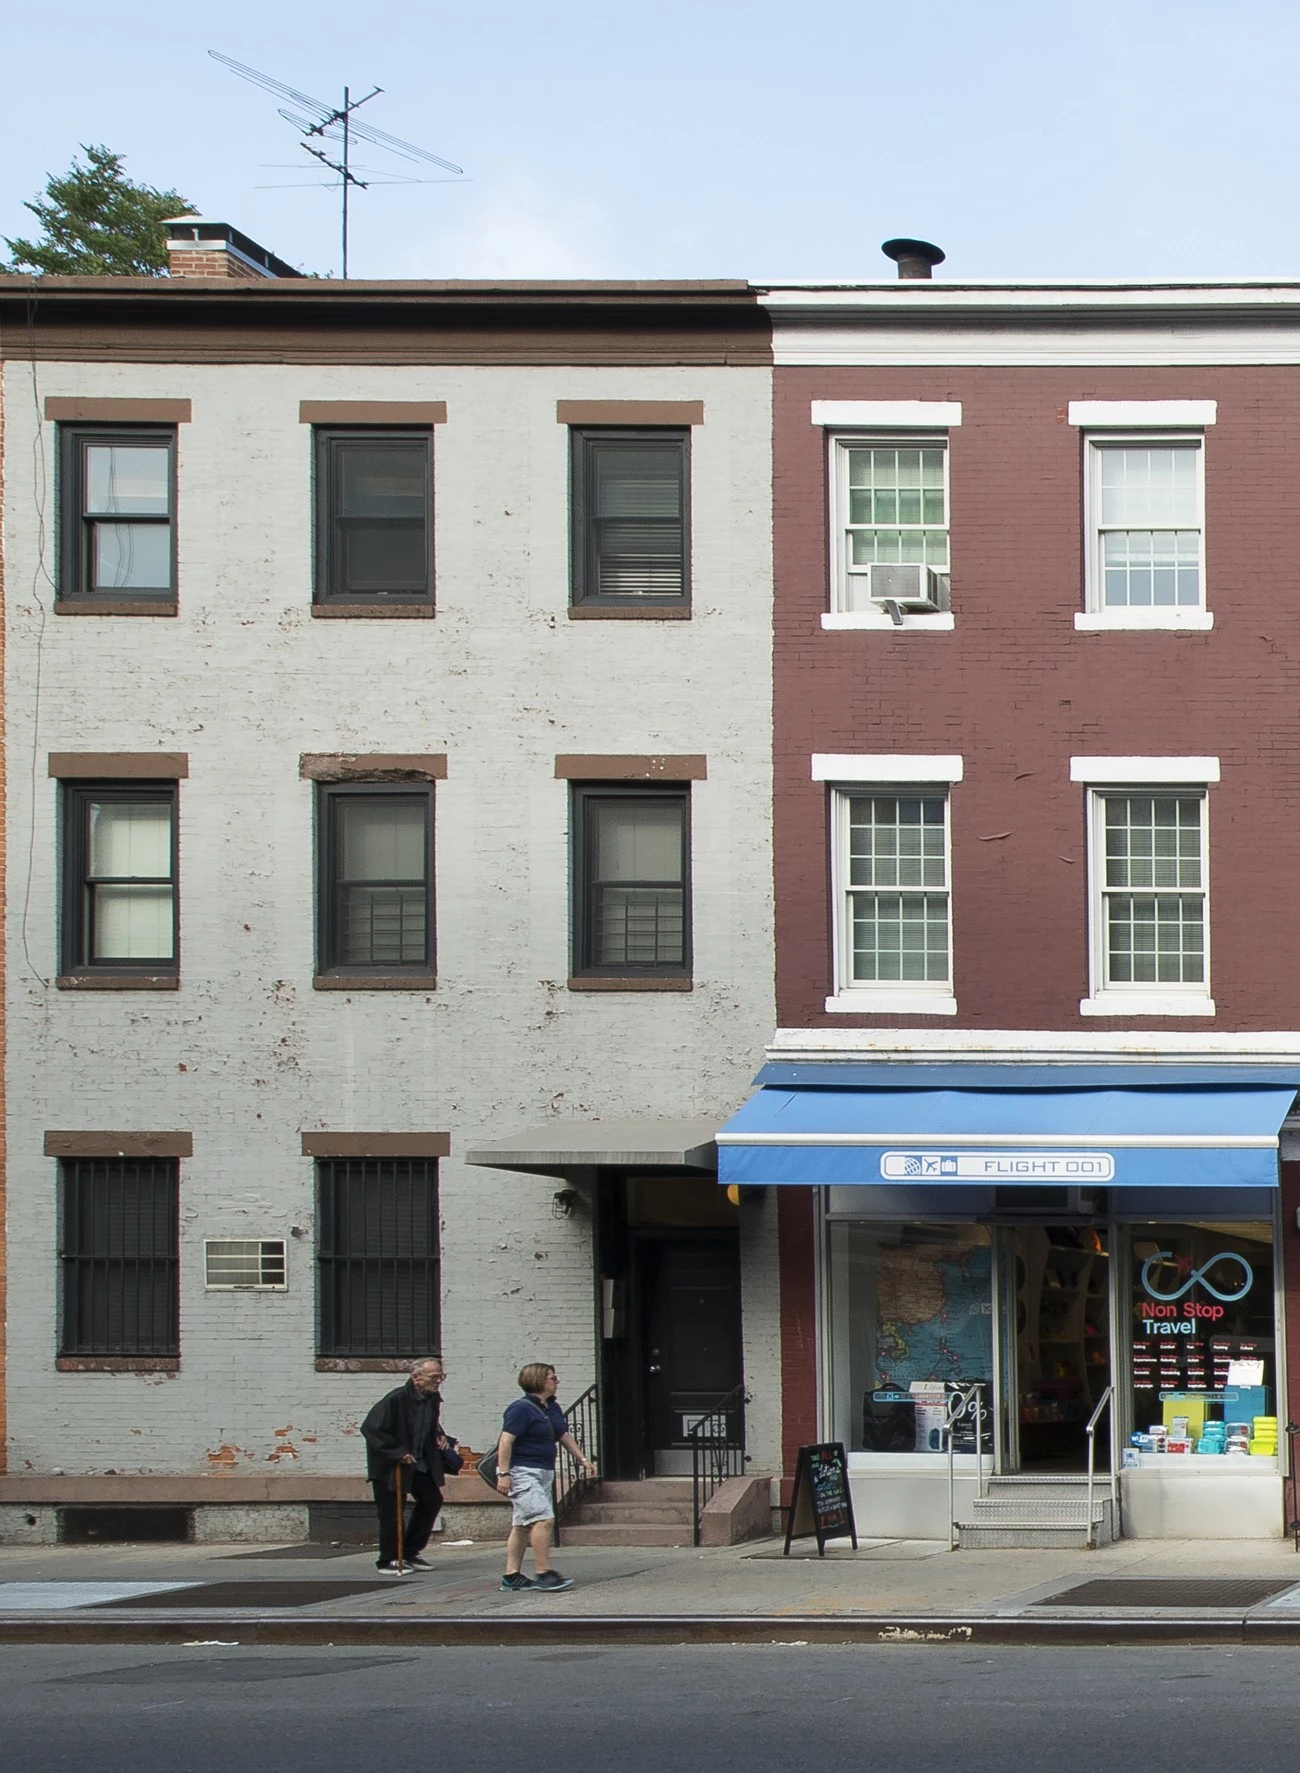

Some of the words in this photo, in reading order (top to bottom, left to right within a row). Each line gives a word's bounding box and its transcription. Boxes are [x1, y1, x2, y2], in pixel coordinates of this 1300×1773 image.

[984, 1161, 1060, 1172] FLIGHT
[1066, 1161, 1102, 1172] 001
[1142, 1303, 1177, 1317] Non
[1183, 1302, 1224, 1321] Stop
[1142, 1318, 1196, 1335] Travel
